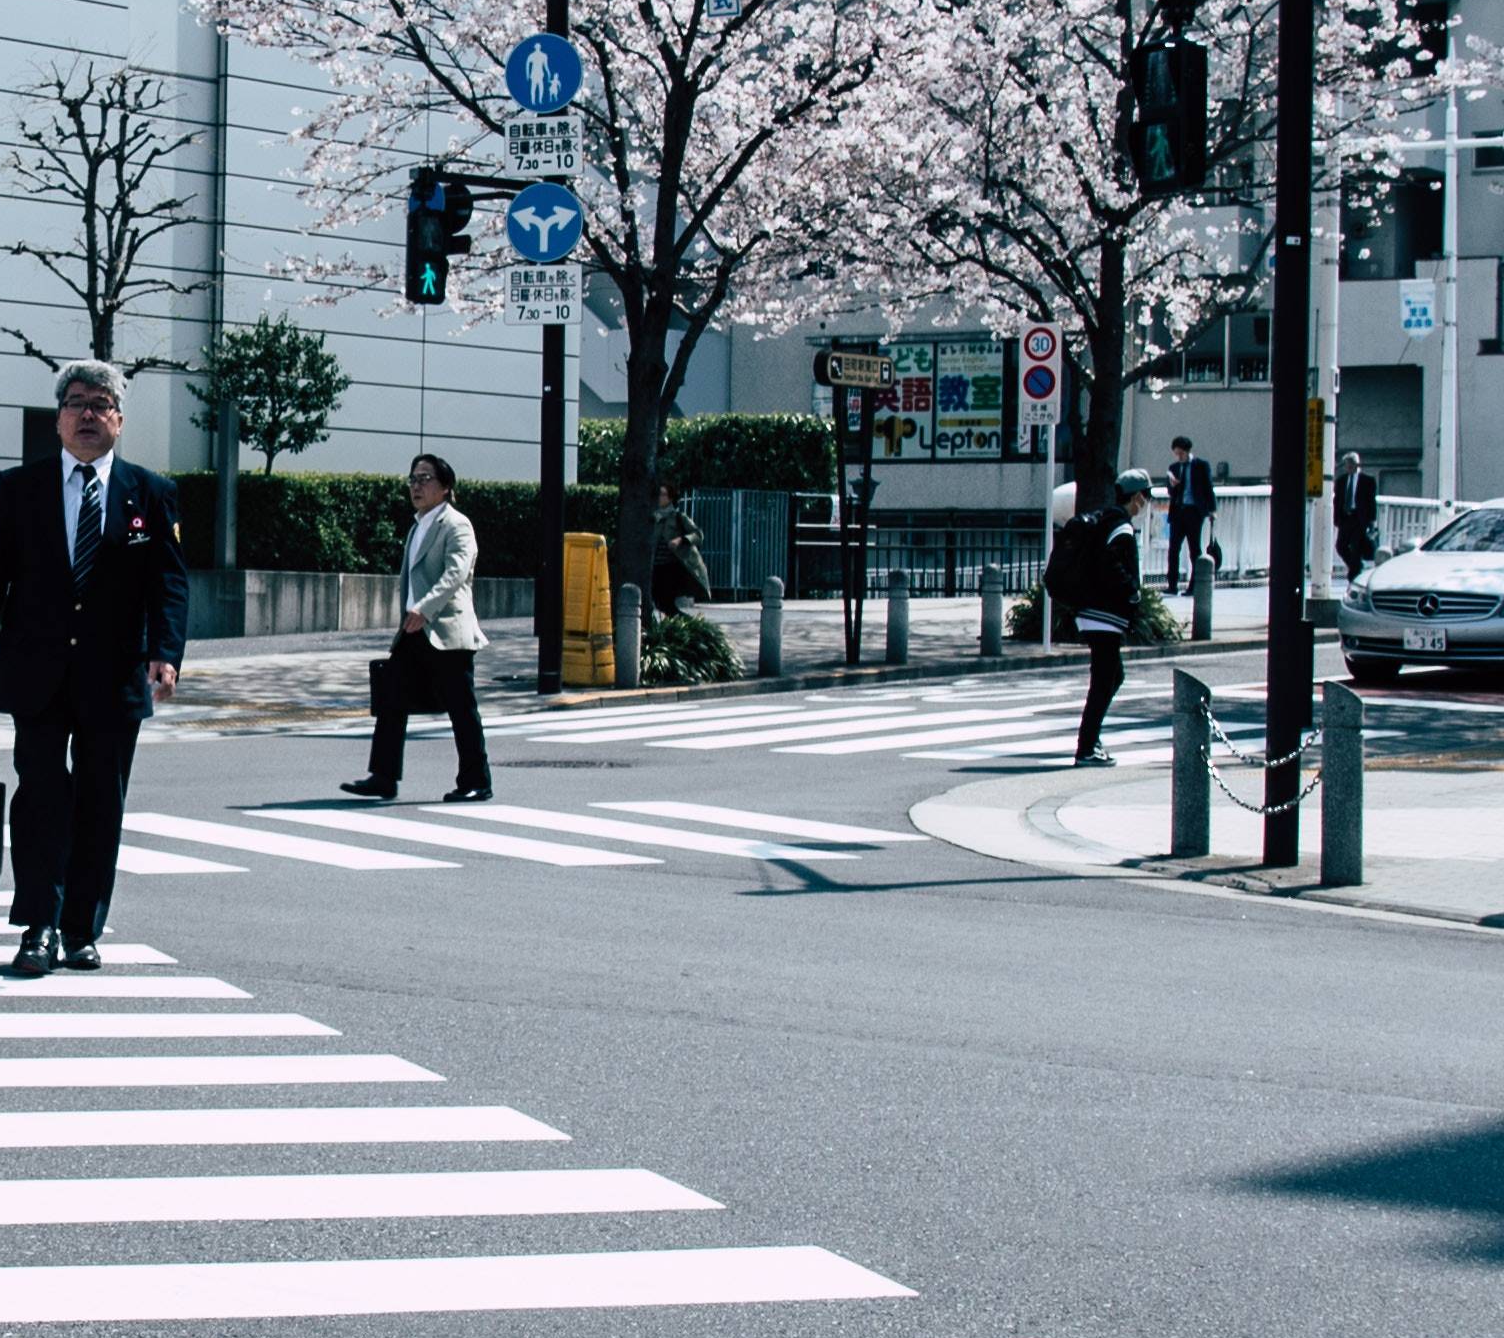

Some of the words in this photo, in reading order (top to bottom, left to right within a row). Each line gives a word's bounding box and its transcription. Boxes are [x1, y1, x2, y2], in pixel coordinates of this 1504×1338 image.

[557, 154, 574, 169] 10
[556, 304, 570, 319] 10
[1031, 336, 1050, 352] 30
[873, 377, 932, 412] 英語
[938, 374, 1002, 412] 教室
[920, 427, 1000, 456] Lepton
